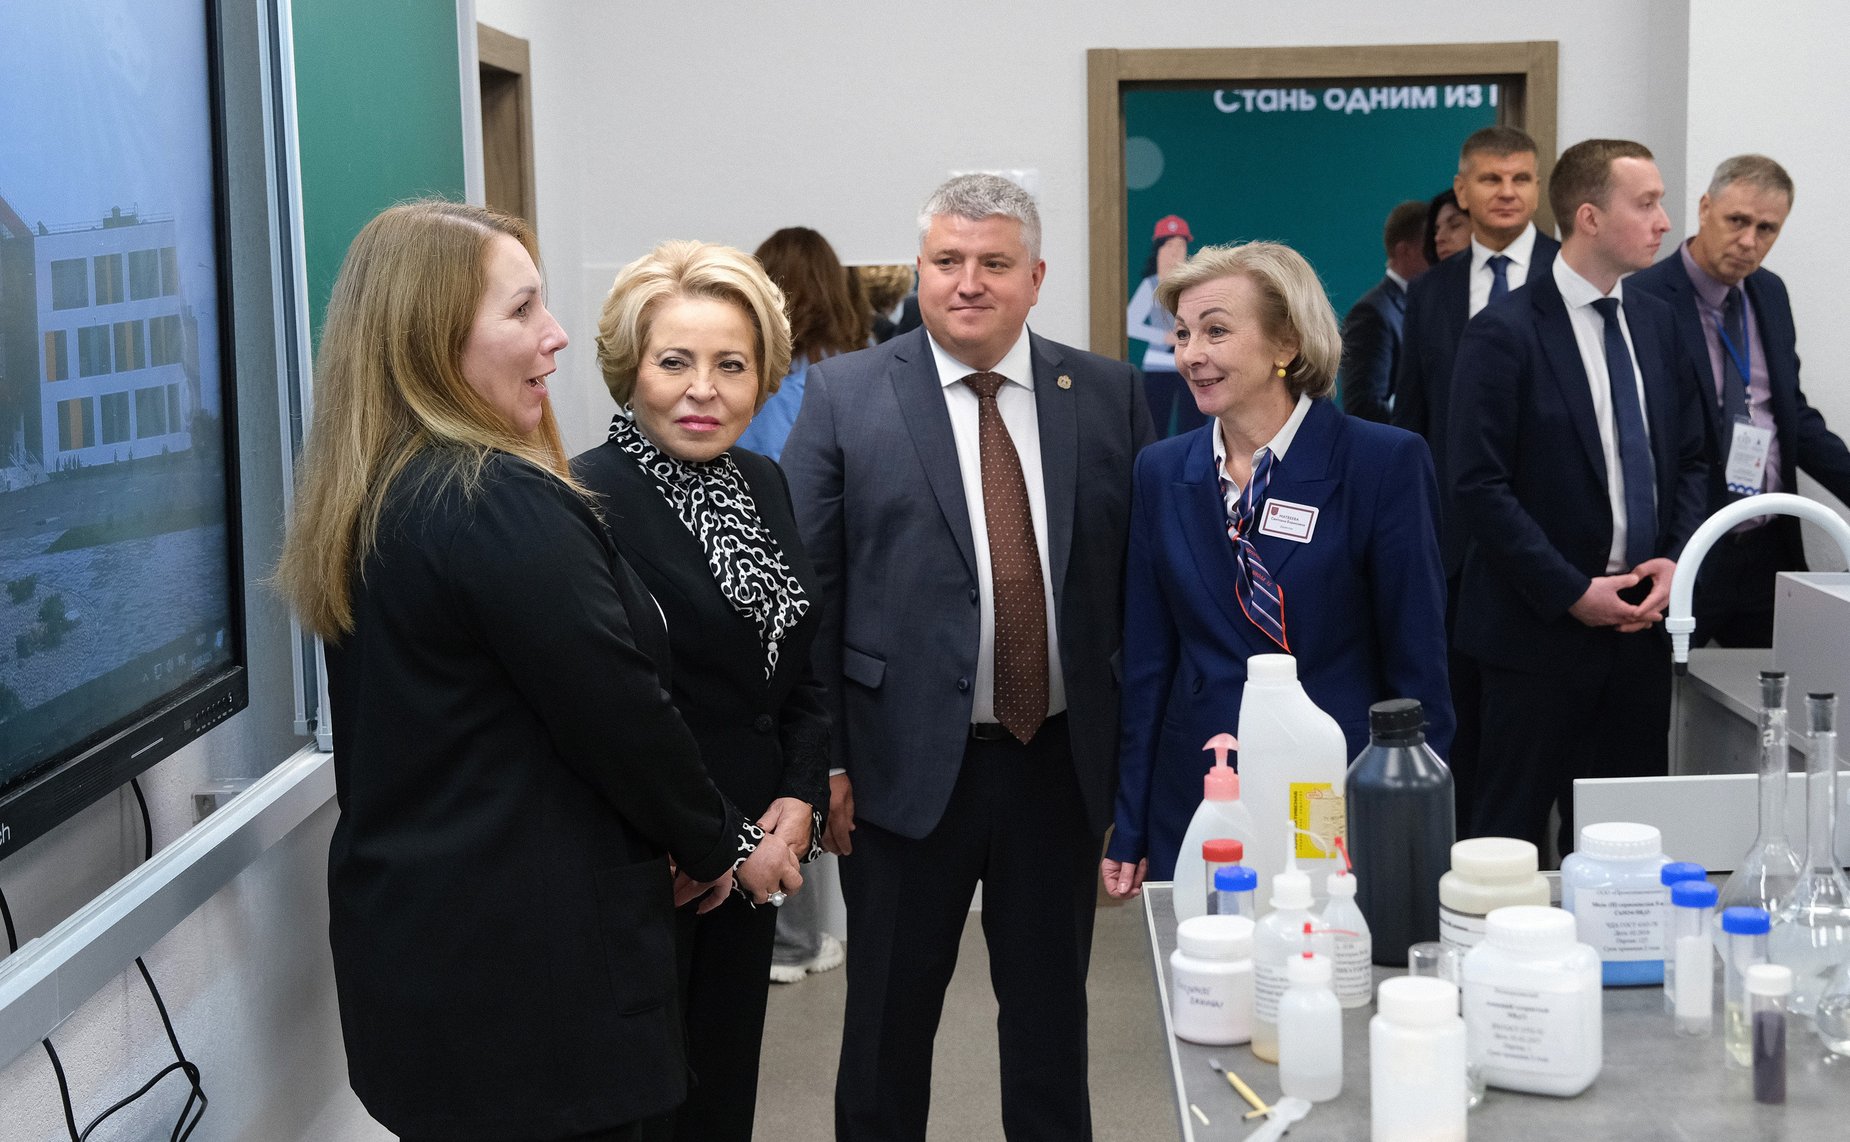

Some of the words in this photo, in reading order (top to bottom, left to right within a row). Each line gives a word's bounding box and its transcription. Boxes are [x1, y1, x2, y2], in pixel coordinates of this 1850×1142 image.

[1213, 88, 1317, 113] Стань
[1323, 87, 1437, 114] одним
[1444, 84, 1482, 109] из
